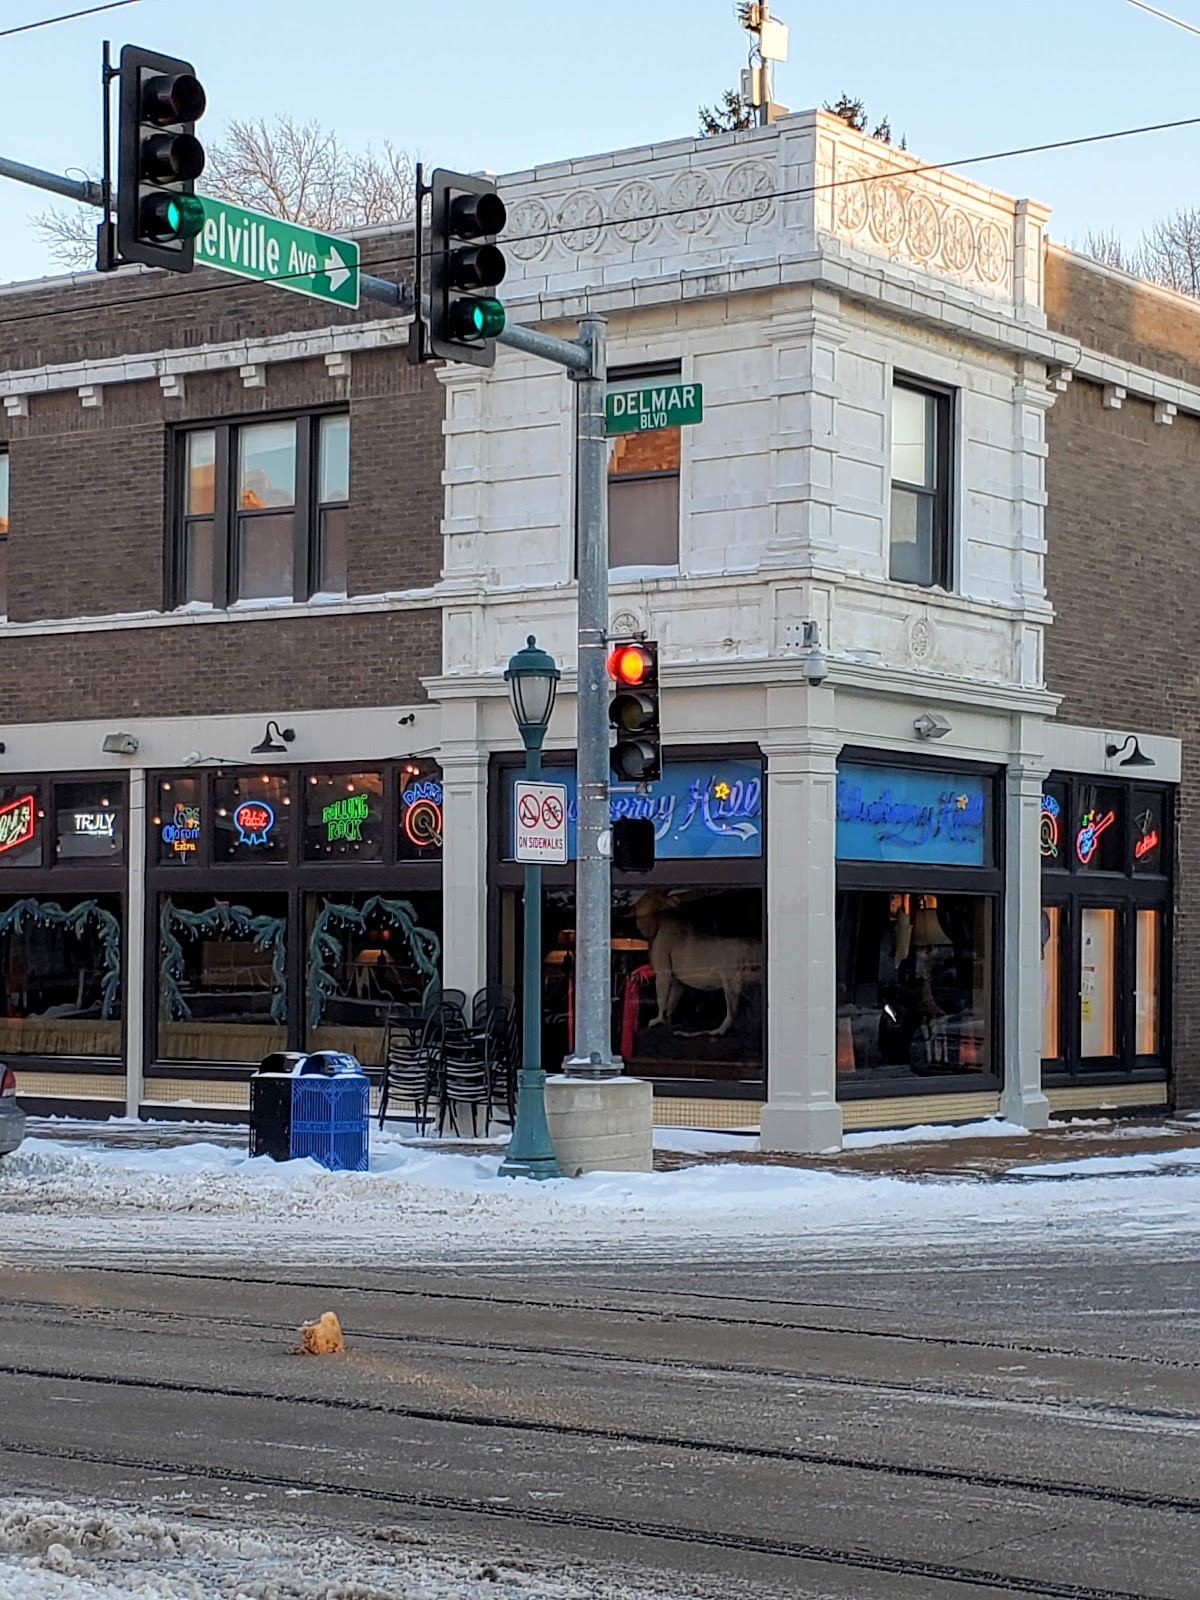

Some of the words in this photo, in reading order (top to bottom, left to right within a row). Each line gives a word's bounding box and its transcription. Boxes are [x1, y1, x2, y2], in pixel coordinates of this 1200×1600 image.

[196, 211, 280, 276] elville
[288, 240, 317, 280] Ave
[613, 386, 695, 417] DELMAR
[640, 412, 667, 430] BLVD
[322, 793, 369, 823] ROLLING
[74, 813, 116, 830] TRULY
[327, 818, 363, 842] ROCK
[161, 824, 200, 844] Coron
[519, 837, 528, 849] ON
[528, 837, 564, 850] SIDEWALKS
[173, 840, 197, 852] Extra
